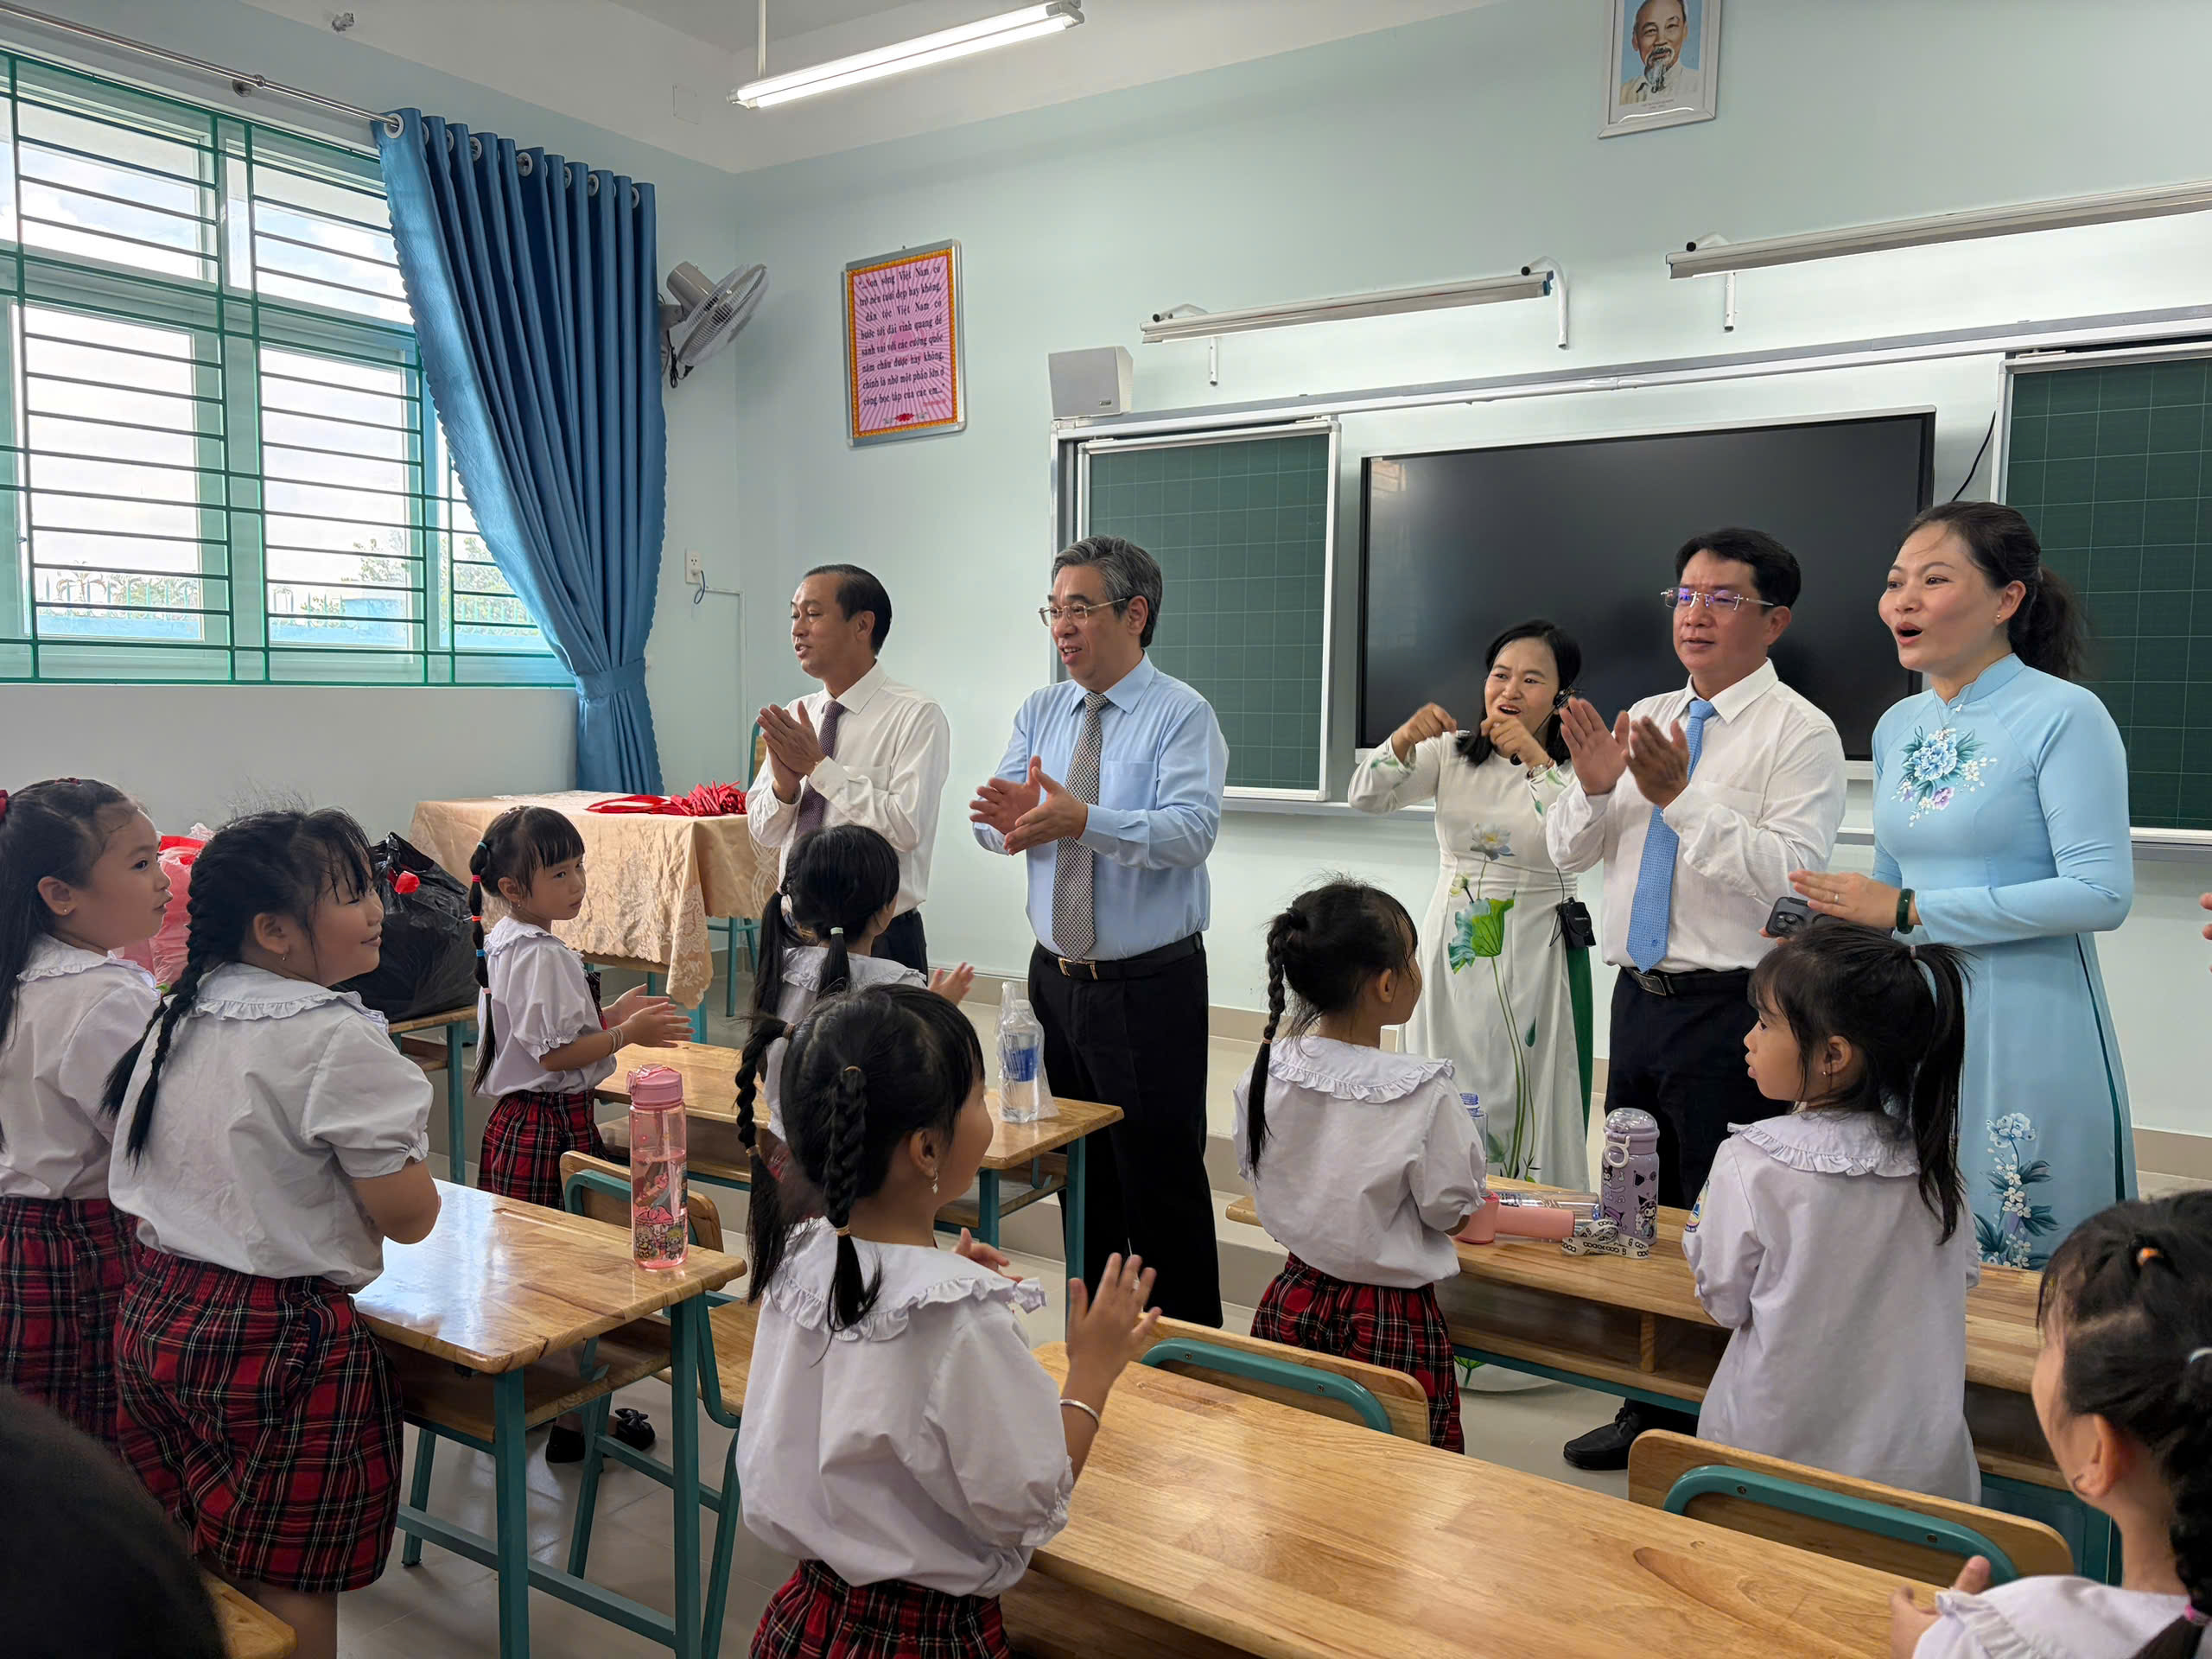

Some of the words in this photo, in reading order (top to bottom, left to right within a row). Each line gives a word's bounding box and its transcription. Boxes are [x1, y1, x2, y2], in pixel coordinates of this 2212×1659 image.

[899, 270, 912, 281] Việt
[915, 267, 930, 277] Nam
[908, 286, 920, 297] hay
[897, 305, 911, 316] Việt
[915, 302, 930, 312] Nam
[899, 321, 912, 332] vinh
[914, 318, 933, 332] quang
[877, 343, 886, 353] vai
[910, 354, 922, 365] hay
